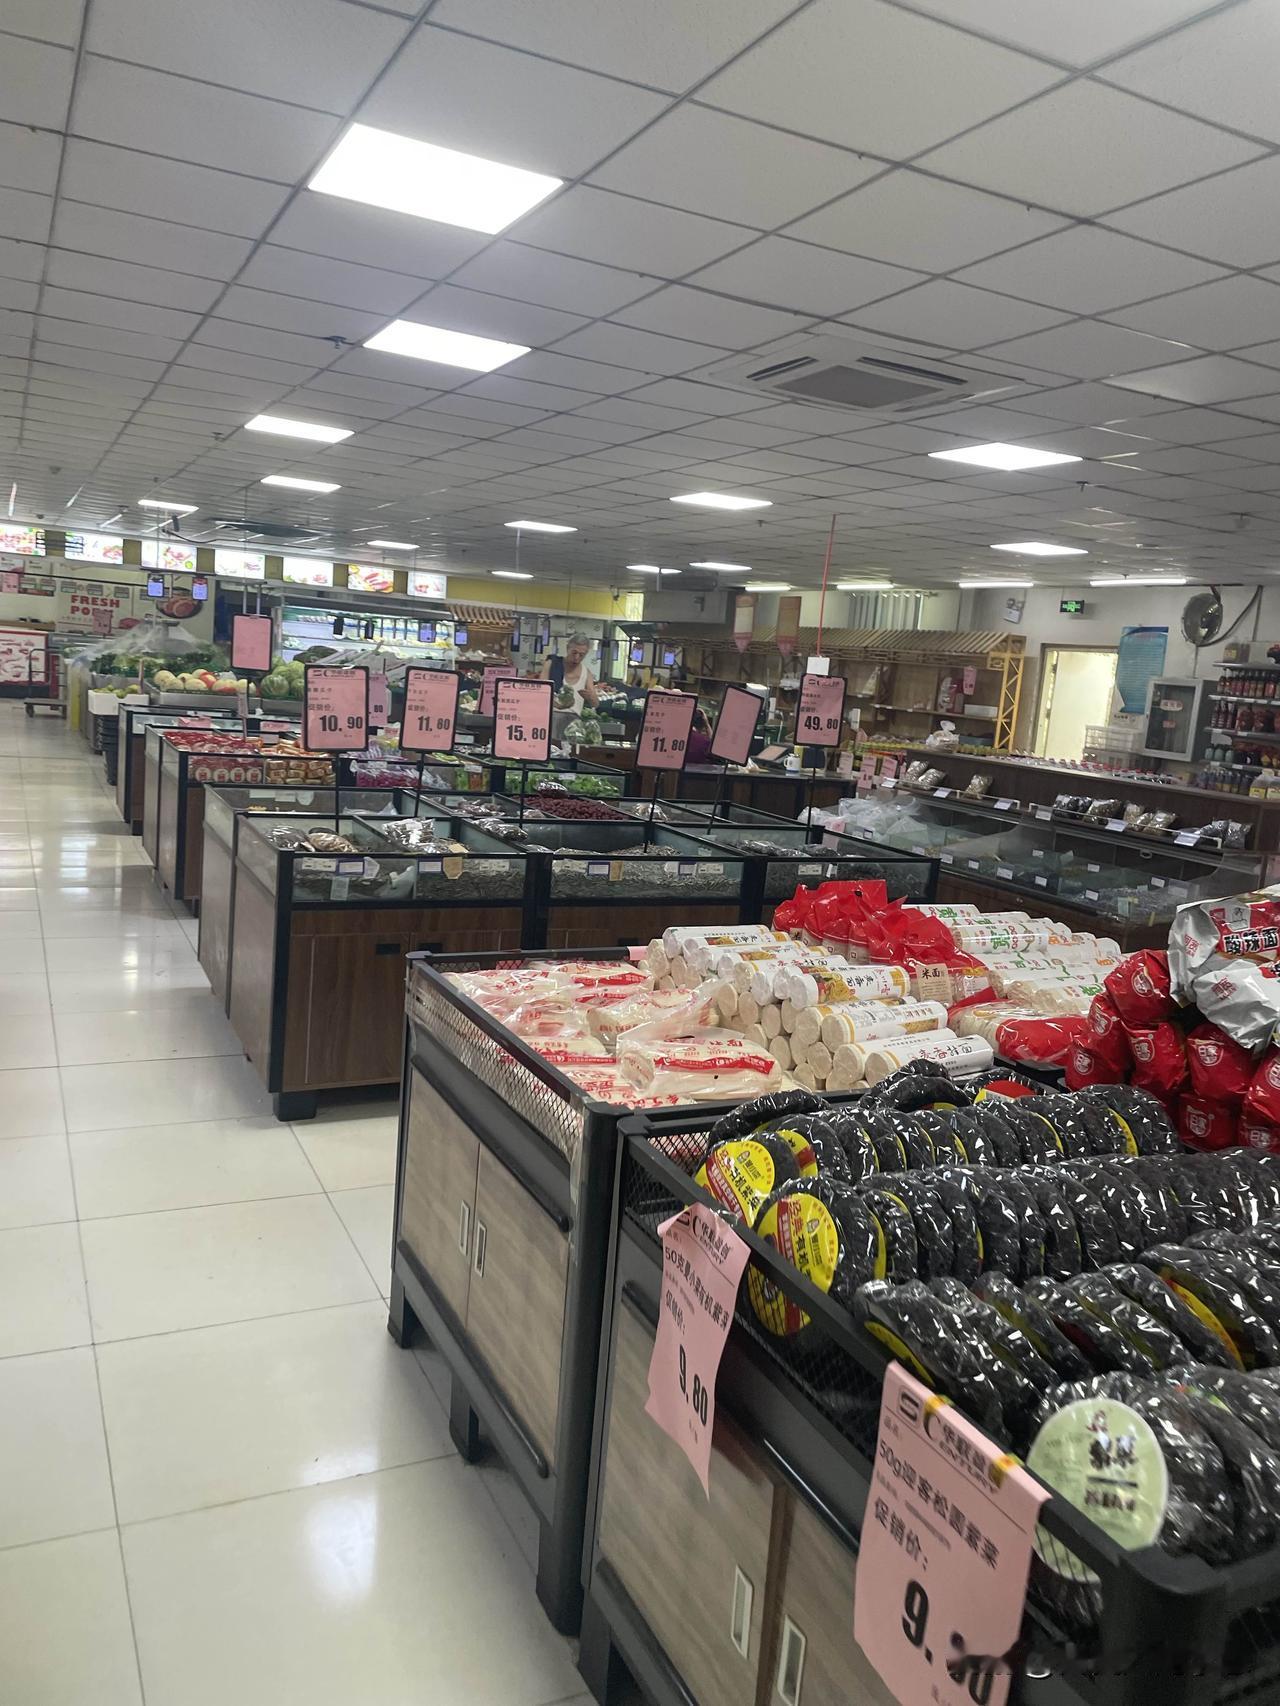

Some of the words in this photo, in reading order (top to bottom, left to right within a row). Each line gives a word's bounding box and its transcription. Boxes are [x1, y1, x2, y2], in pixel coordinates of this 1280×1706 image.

[71, 595, 120, 608] FRESH
[320, 715, 363, 732] 10.90
[418, 715, 450, 732] 11.80
[804, 716, 839, 731] 49.80
[506, 724, 546, 741] 15.80
[653, 737, 685, 752] 11.80
[921, 967, 942, 980] 米面
[788, 1199, 811, 1282] 经典有机
[678, 1345, 709, 1427] 9.80
